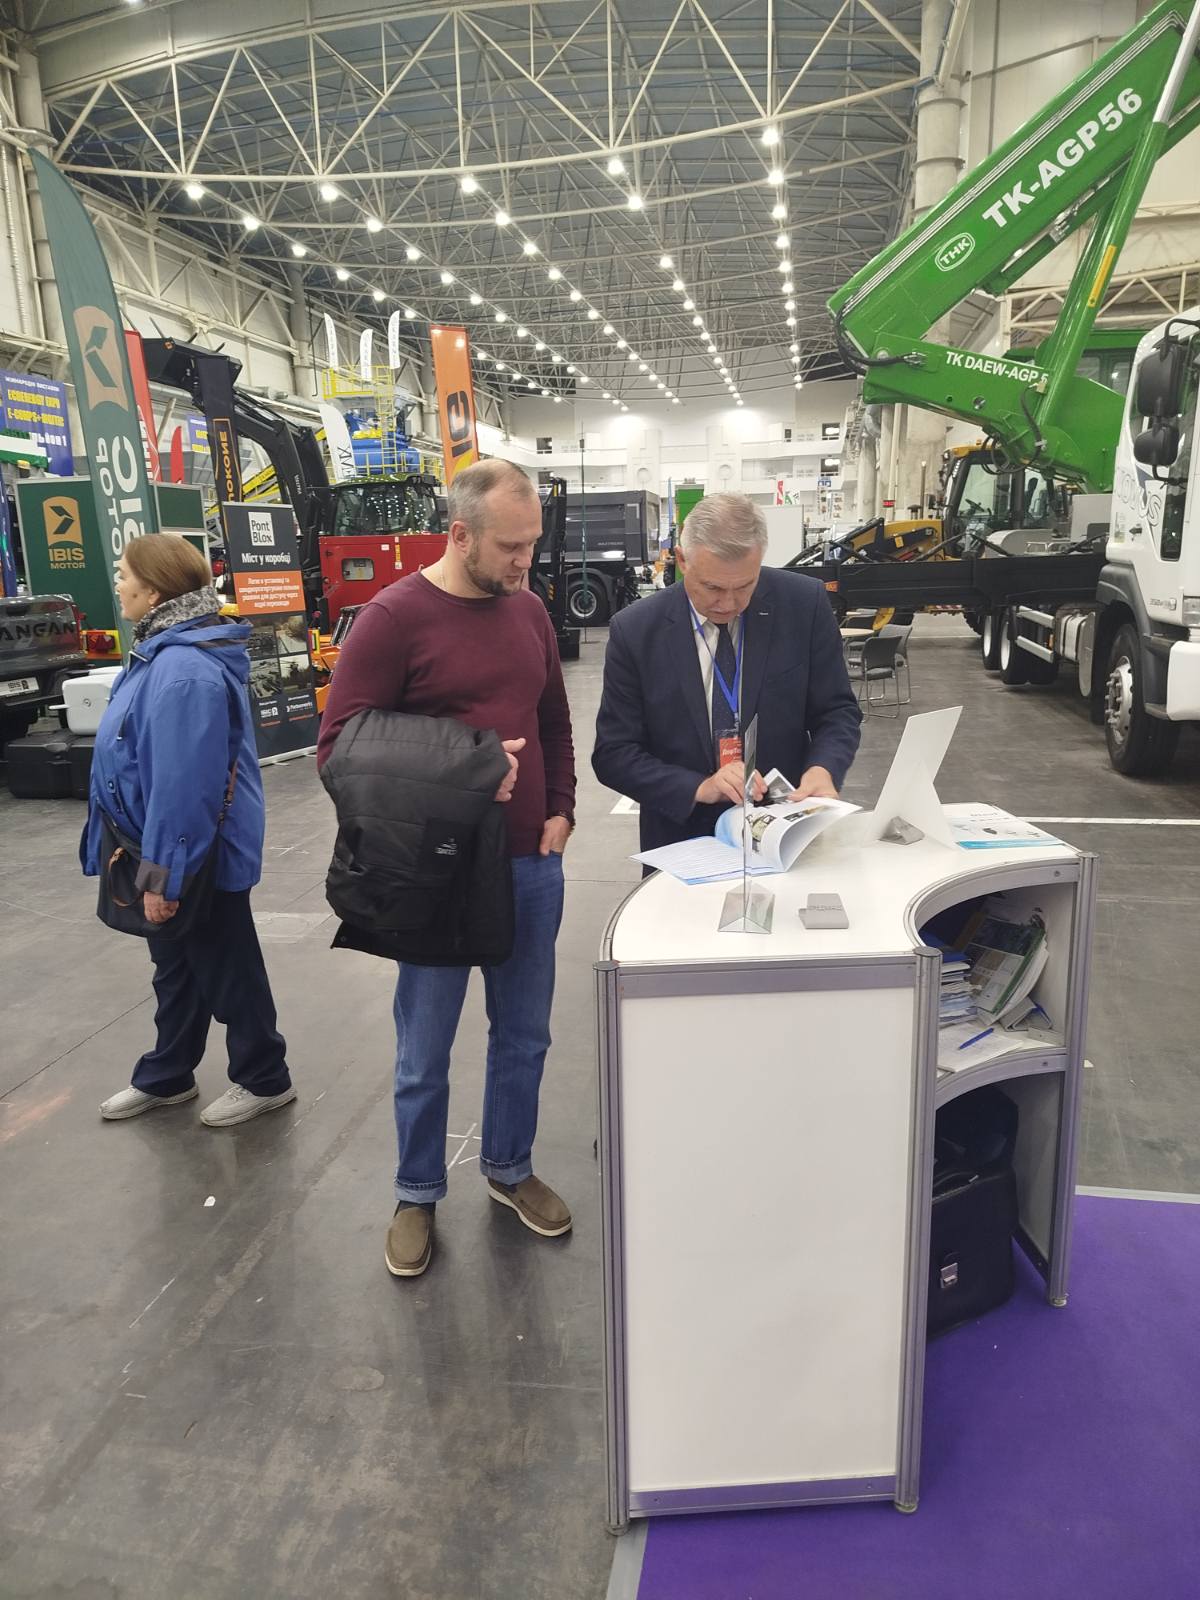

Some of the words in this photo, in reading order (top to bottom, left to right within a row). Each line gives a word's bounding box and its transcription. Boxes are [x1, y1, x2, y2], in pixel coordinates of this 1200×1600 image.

[981, 87, 1143, 228] TK-AGP56
[946, 351, 964, 367] TK
[964, 355, 1039, 382] DAEW-AGP
[251, 519, 270, 532] Pont
[48, 547, 85, 562] IBIS
[50, 562, 86, 570] MOTOR
